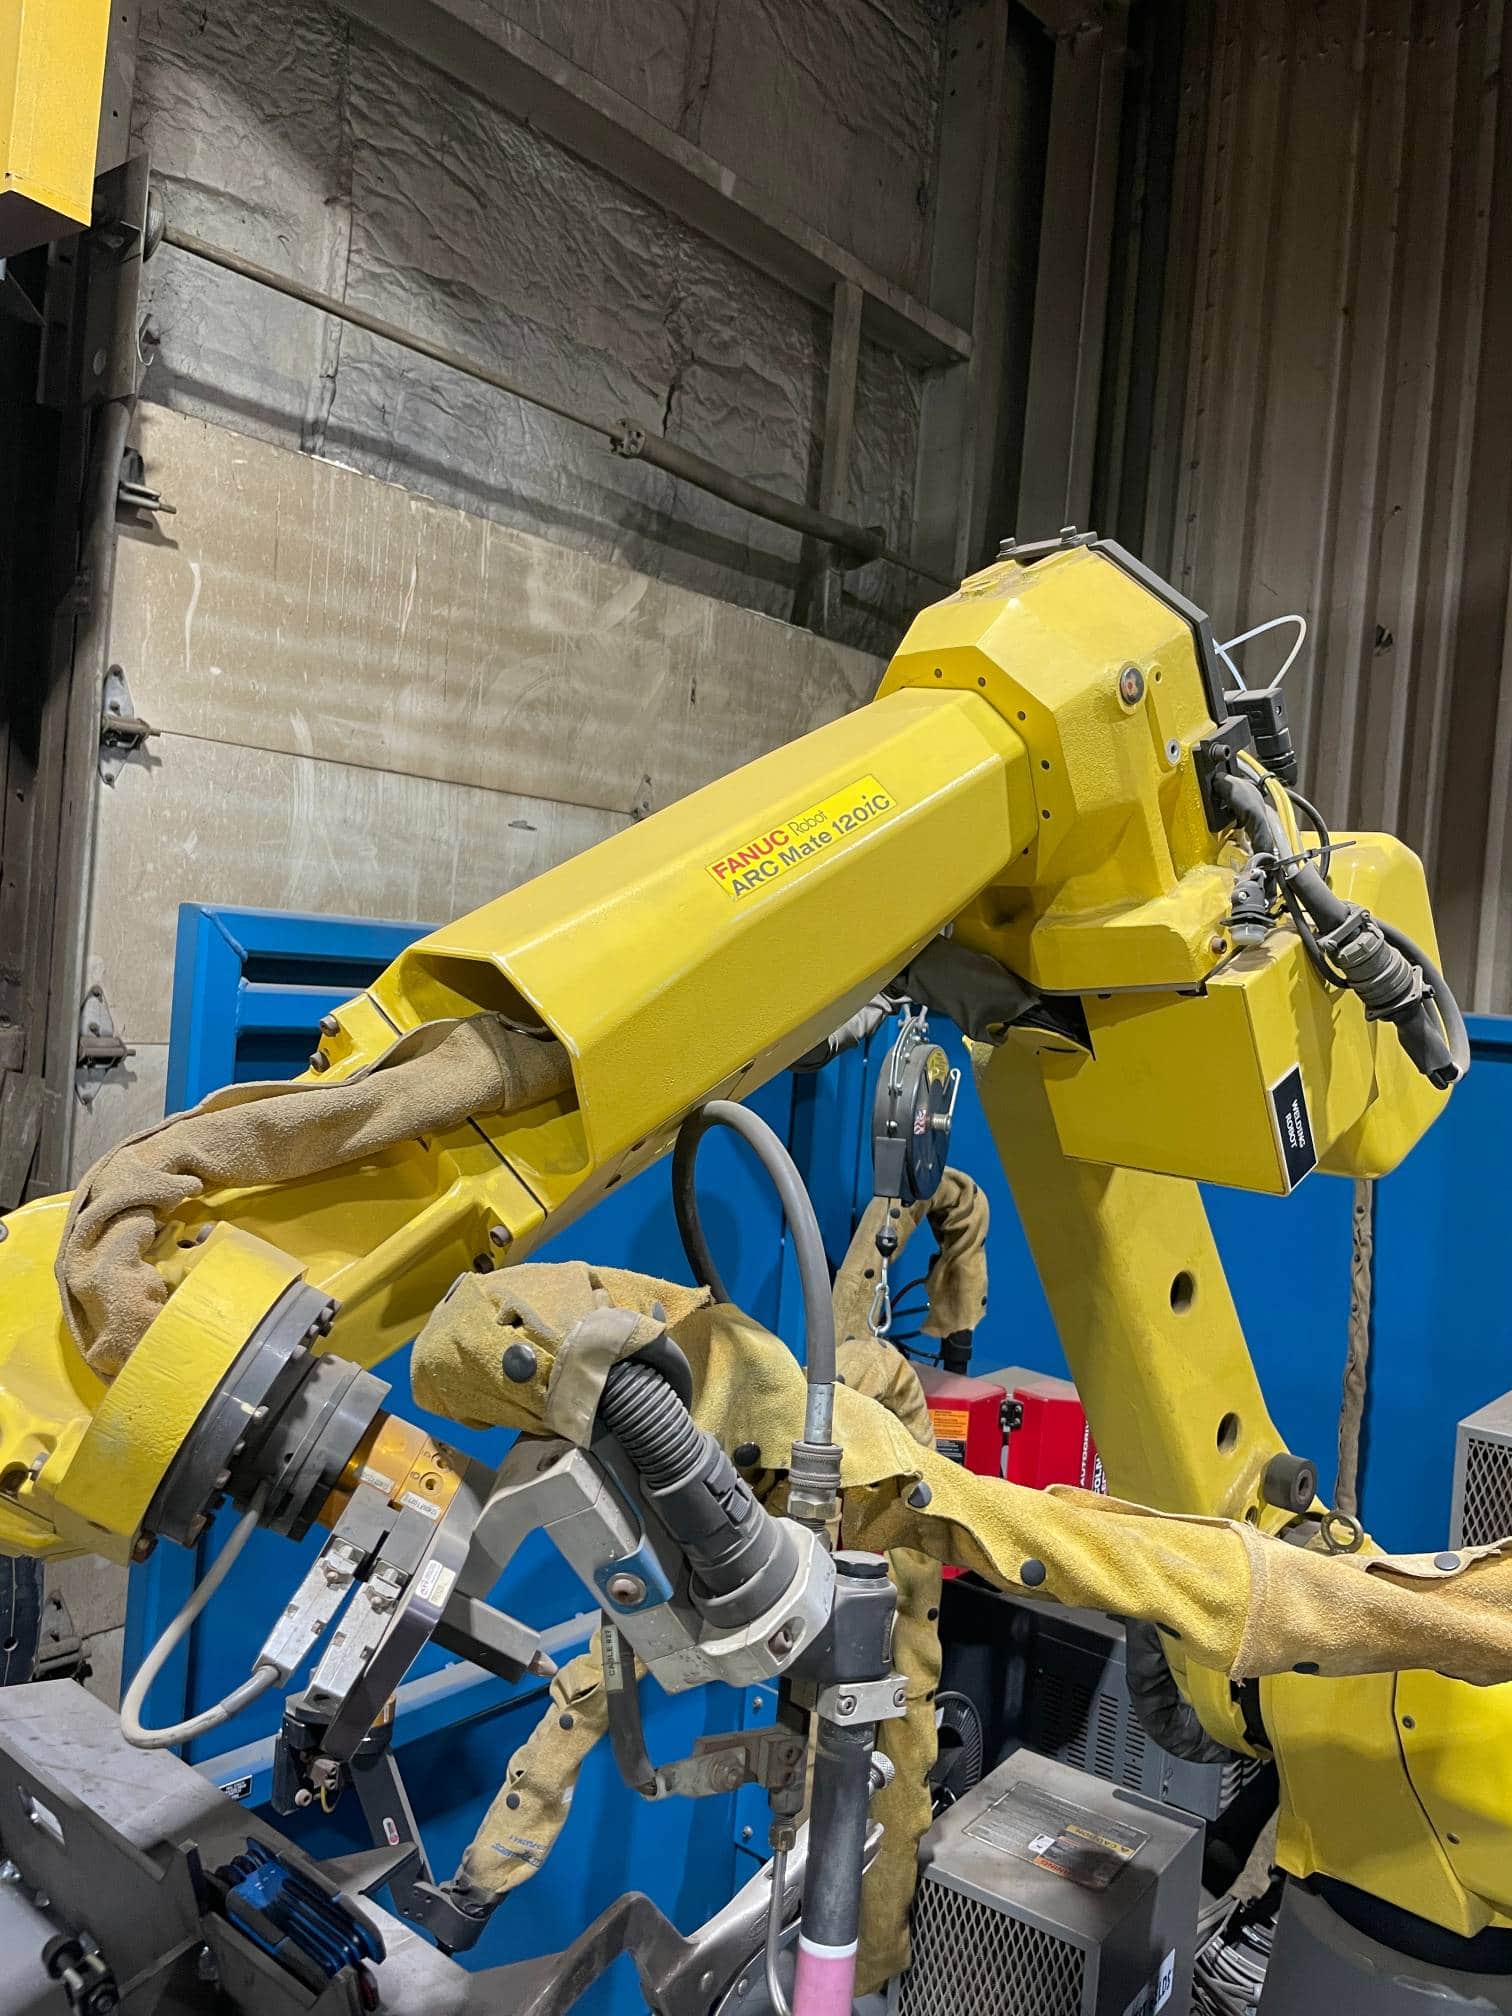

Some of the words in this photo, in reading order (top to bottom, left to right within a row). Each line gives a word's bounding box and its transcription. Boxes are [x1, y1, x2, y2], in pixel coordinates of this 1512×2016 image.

[711, 830, 790, 880] FANUC
[787, 809, 828, 837] Robot
[731, 860, 780, 897] ARC
[778, 831, 833, 867] Mate
[832, 794, 890, 834] 120iC
[1285, 1112, 1298, 1148] ROBOT
[1291, 1098, 1306, 1148] WELDING
